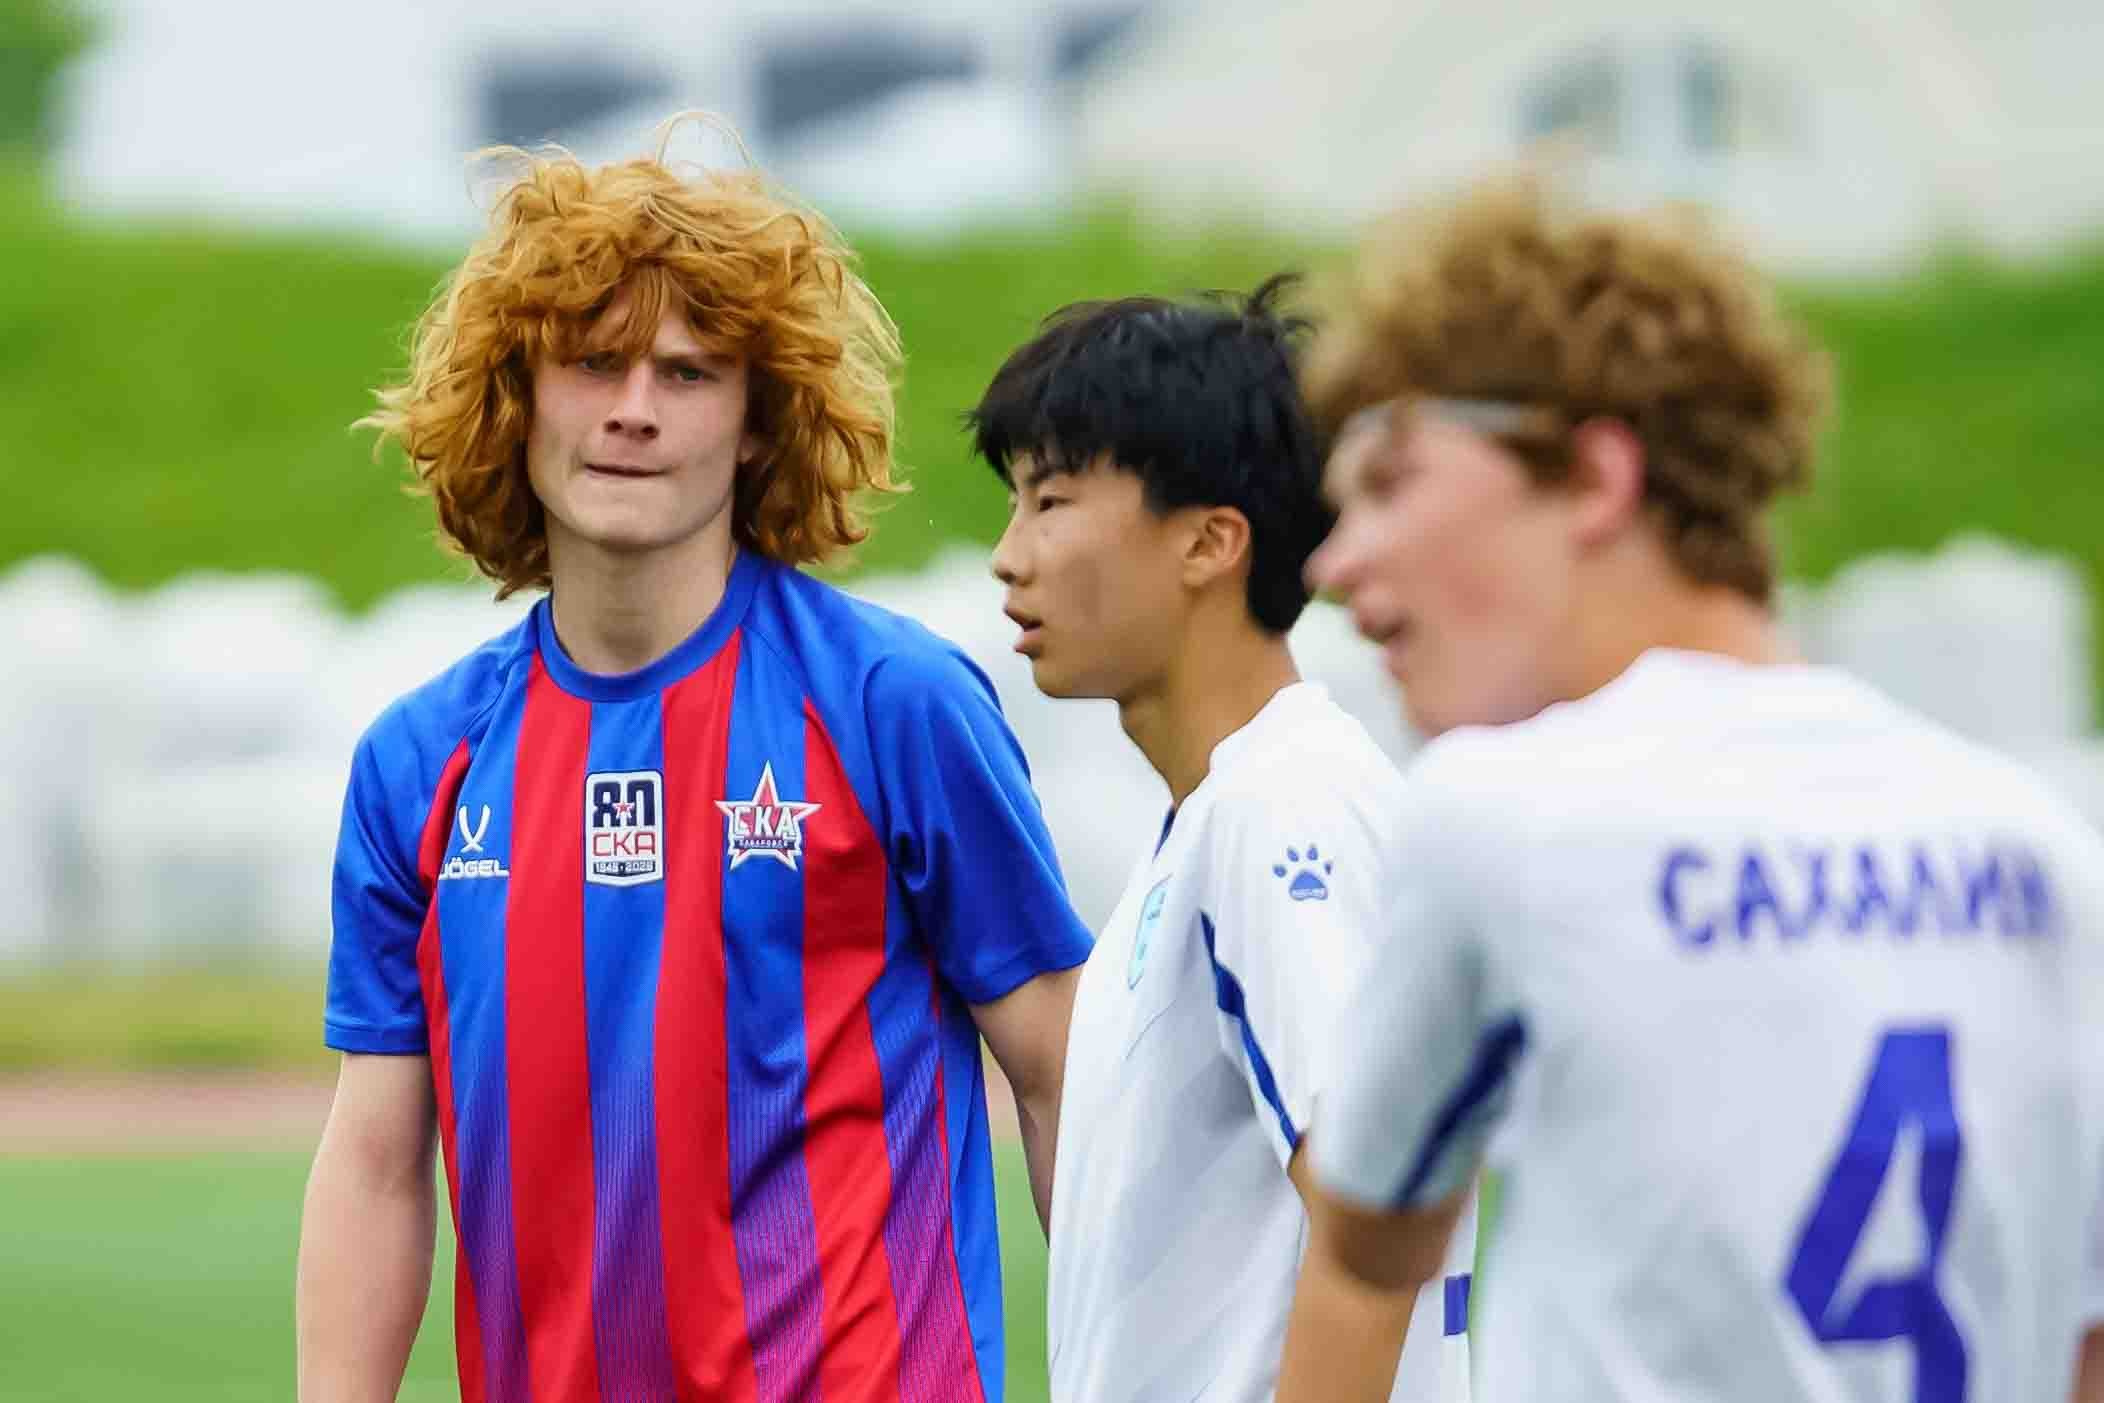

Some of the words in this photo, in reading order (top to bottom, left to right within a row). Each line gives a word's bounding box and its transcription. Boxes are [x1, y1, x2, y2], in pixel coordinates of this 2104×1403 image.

[593, 832, 655, 857] СКА
[438, 856, 510, 880] JÖGEL
[1781, 1022, 1970, 1403] 4
